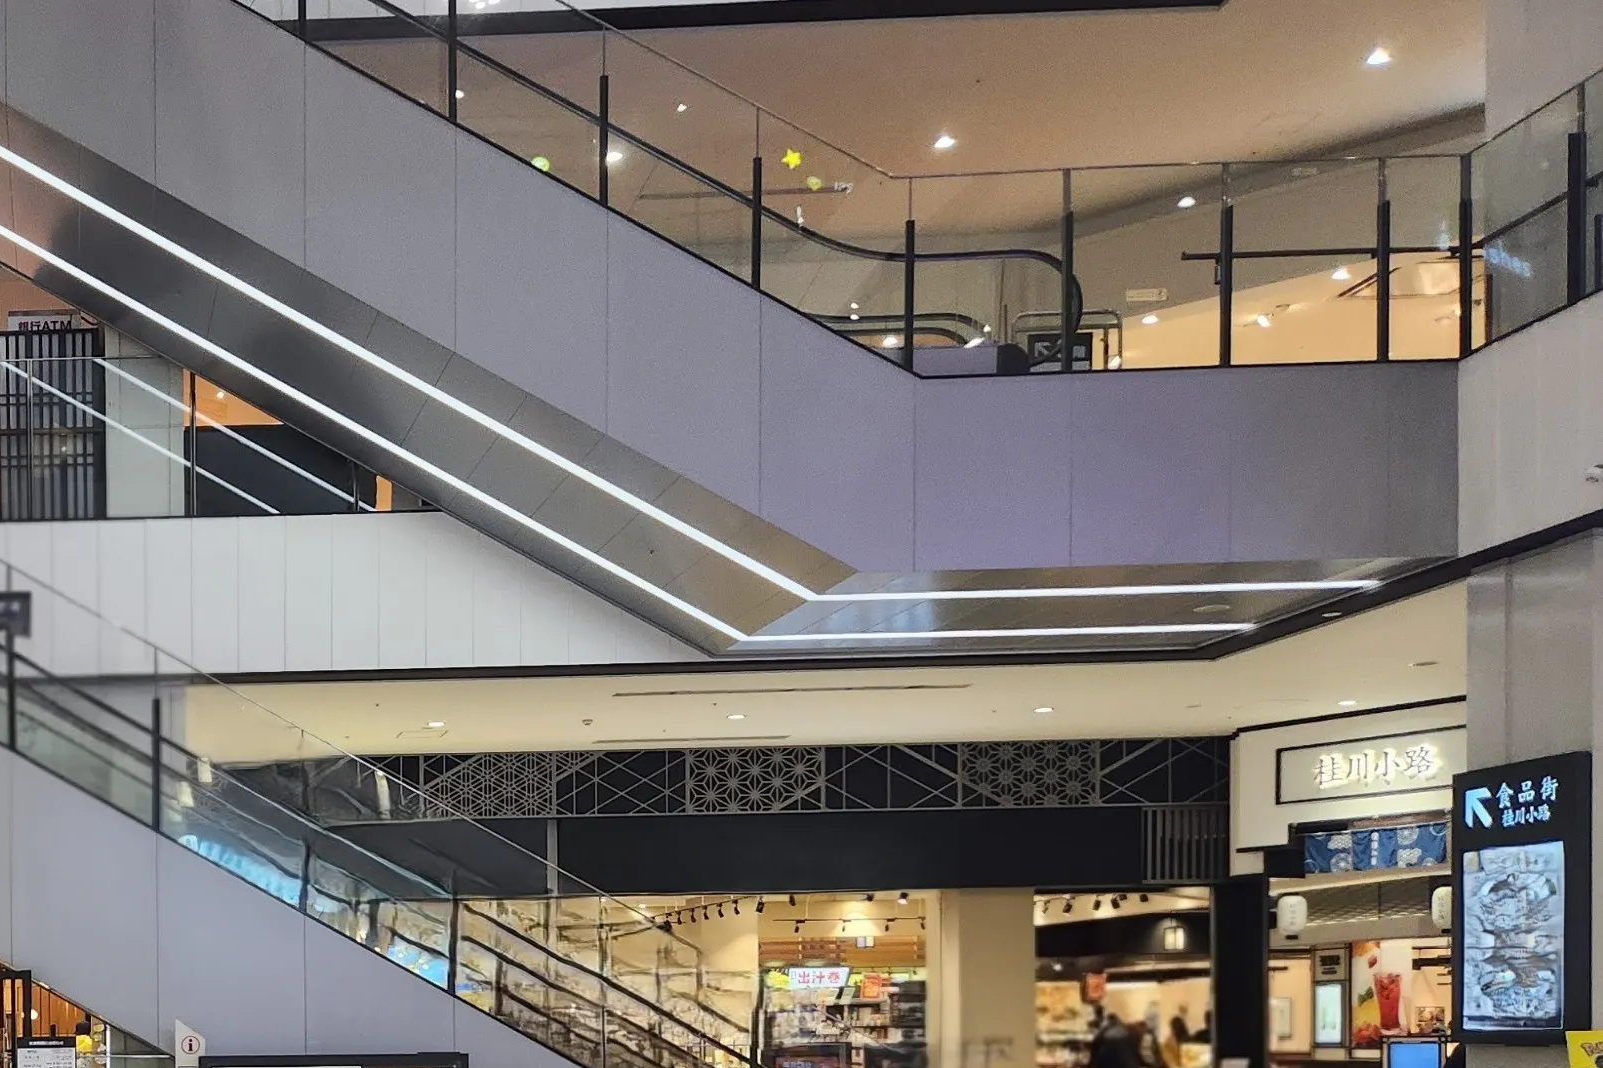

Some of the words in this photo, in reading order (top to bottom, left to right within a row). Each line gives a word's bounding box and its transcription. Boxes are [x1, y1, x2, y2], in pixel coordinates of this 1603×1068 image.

[1313, 746, 1435, 786] 桂川小路
[1496, 776, 1558, 809] 食品街
[1501, 803, 1551, 828] 桂川小路
